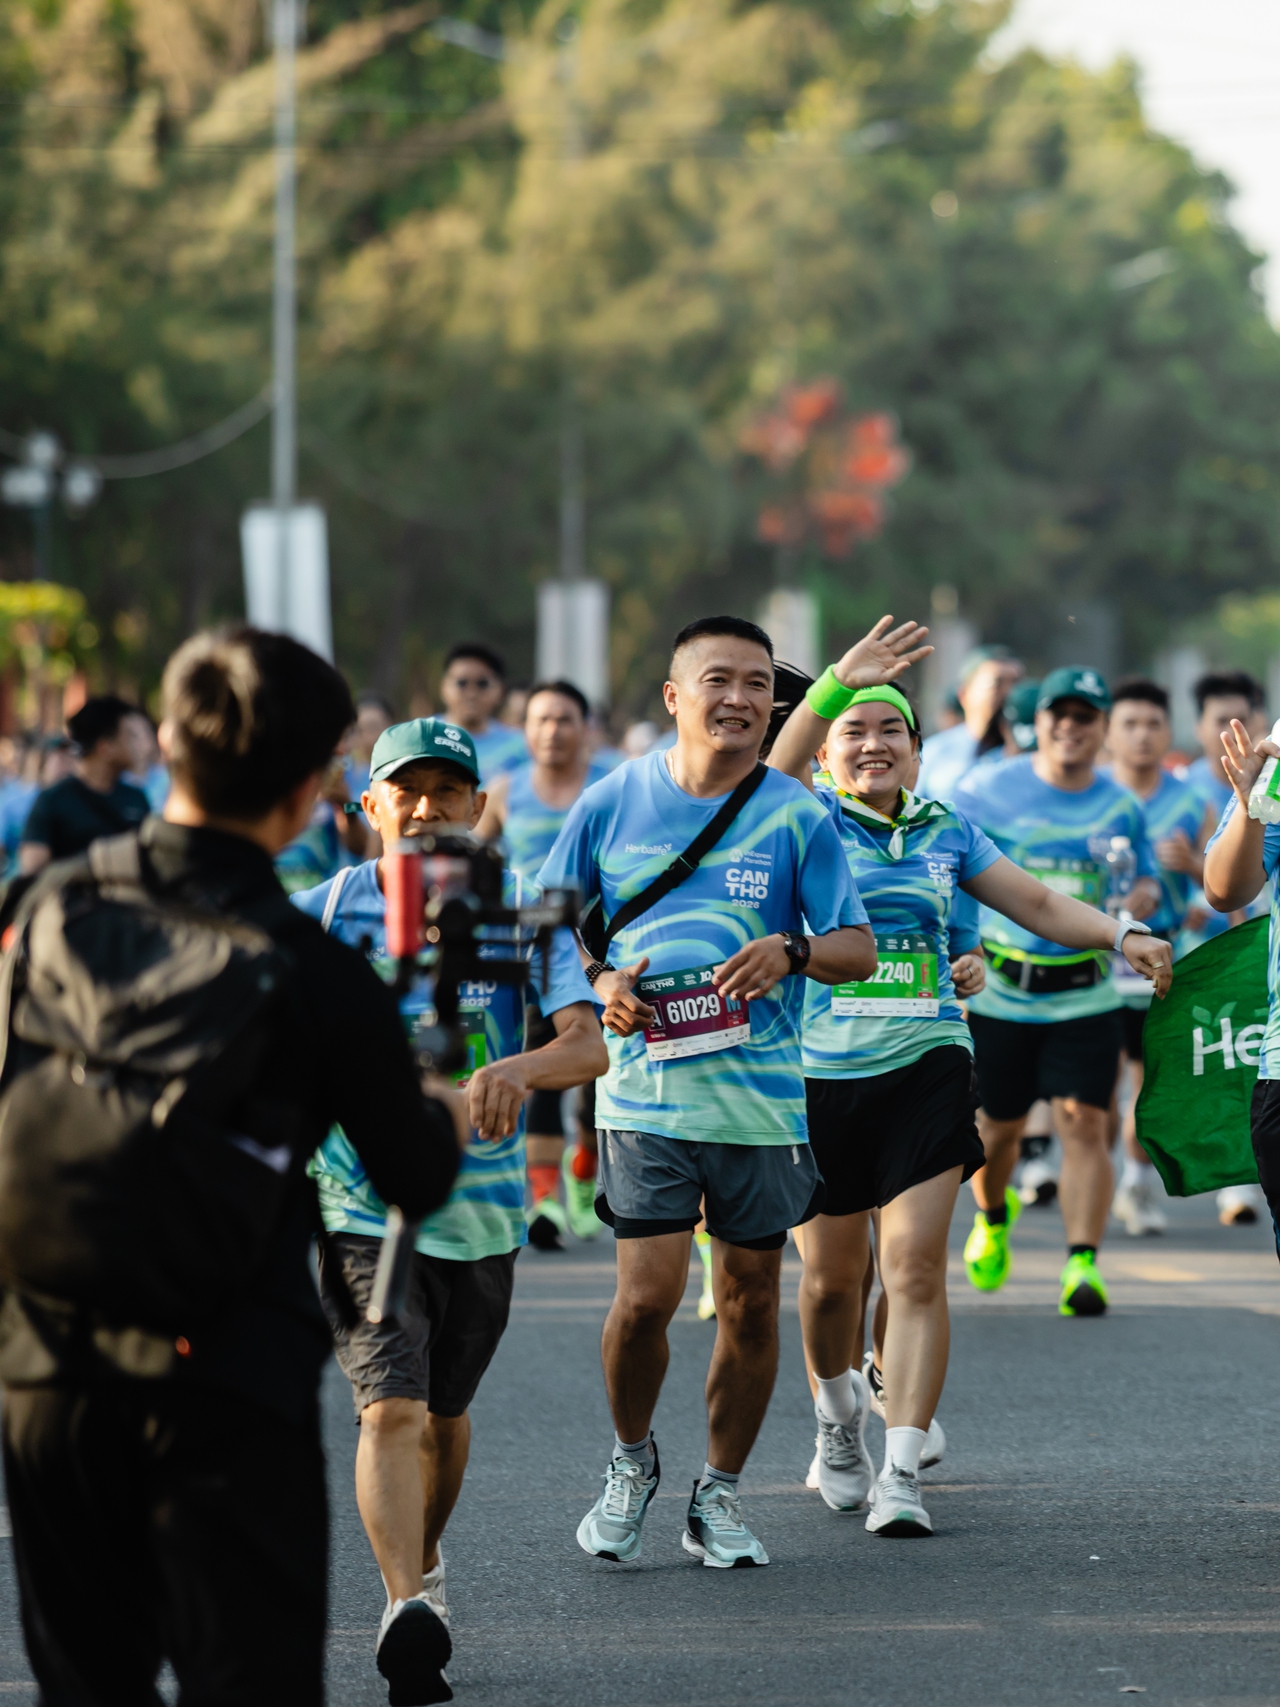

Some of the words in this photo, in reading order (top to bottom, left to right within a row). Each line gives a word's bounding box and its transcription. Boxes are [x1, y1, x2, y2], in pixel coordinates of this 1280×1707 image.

[625, 843, 668, 856] Herbalife
[725, 867, 770, 887] CAN
[725, 881, 769, 900] THO
[731, 898, 761, 910] 2026
[864, 961, 915, 984] 2240
[921, 963, 929, 985] F
[666, 993, 721, 1025] 61029
[1193, 1016, 1267, 1076] He
